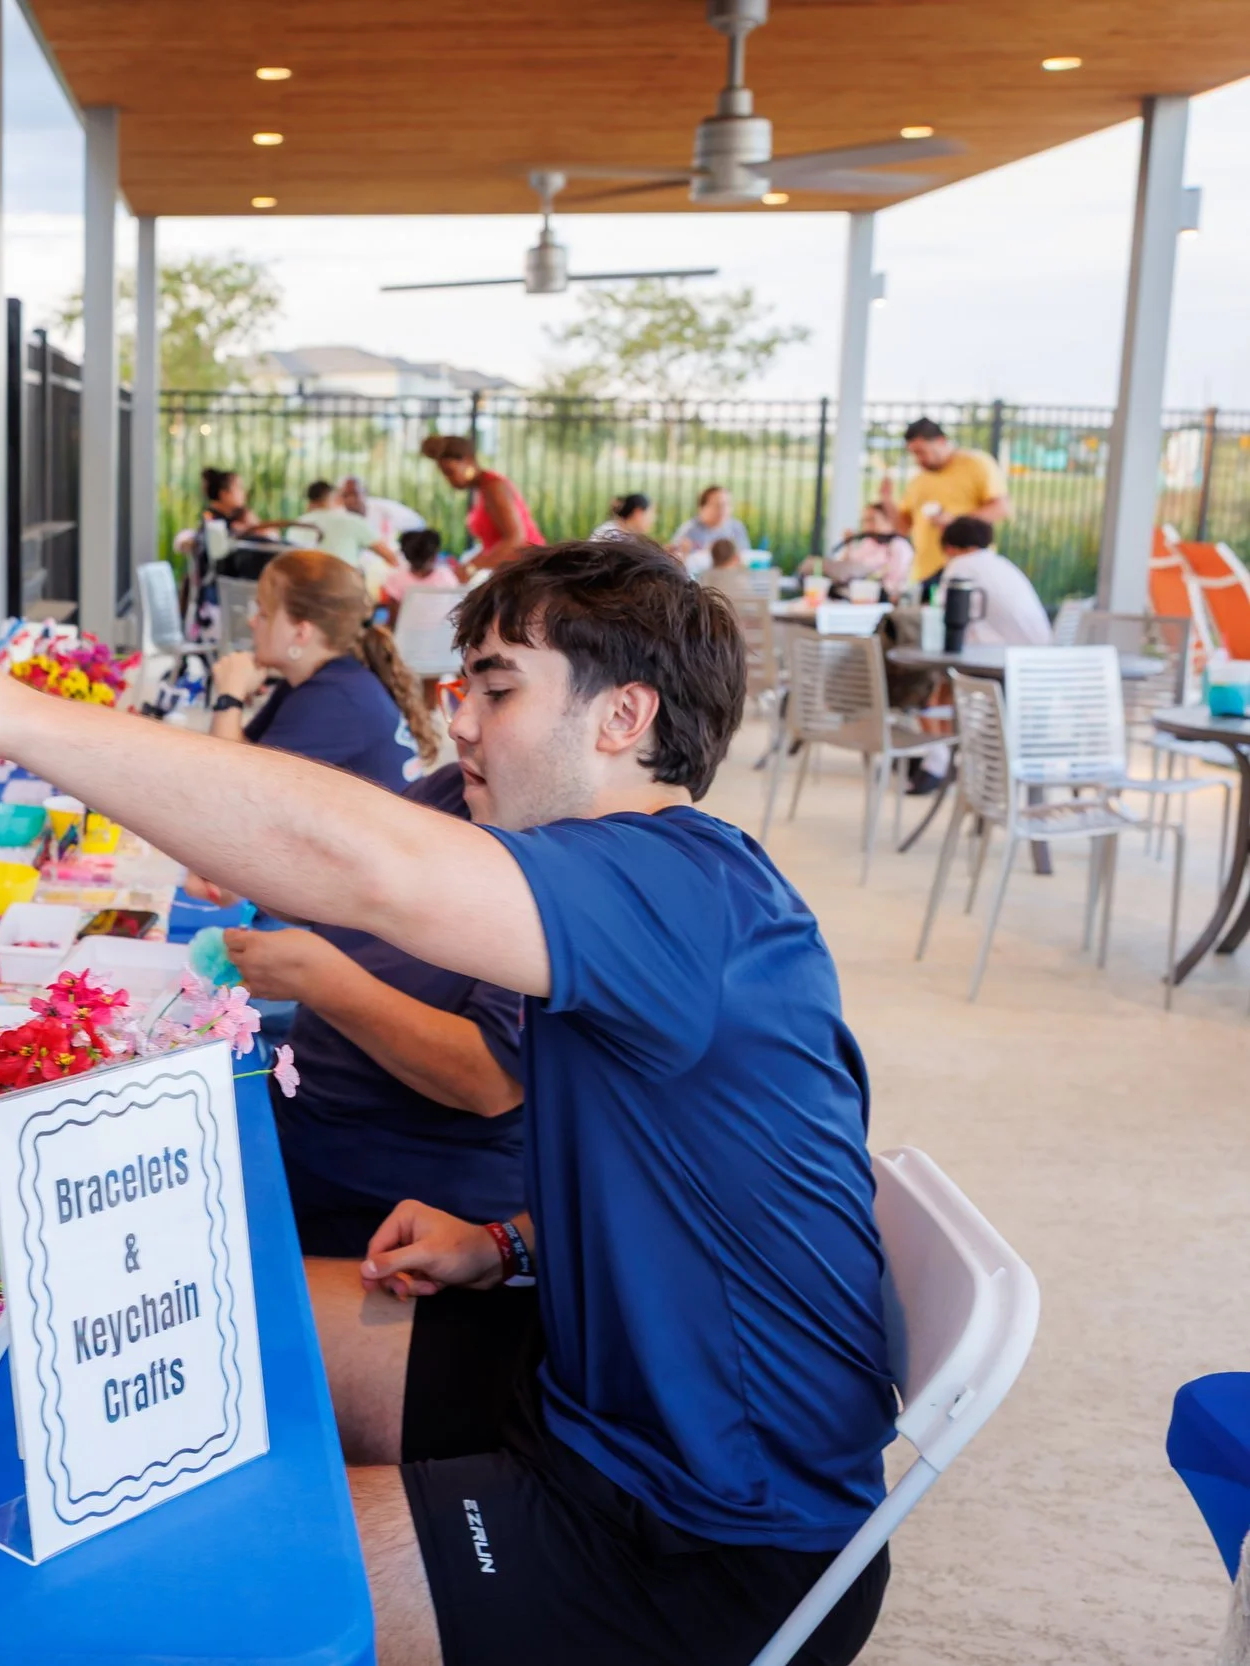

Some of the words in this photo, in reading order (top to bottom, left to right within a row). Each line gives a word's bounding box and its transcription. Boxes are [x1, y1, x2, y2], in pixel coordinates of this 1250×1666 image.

[55, 1146, 189, 1225] Bracelets
[125, 1232, 140, 1274] &
[72, 1279, 201, 1365] Keychain
[104, 1357, 185, 1424] Crafts
[462, 1499, 496, 1573] EZRUN
